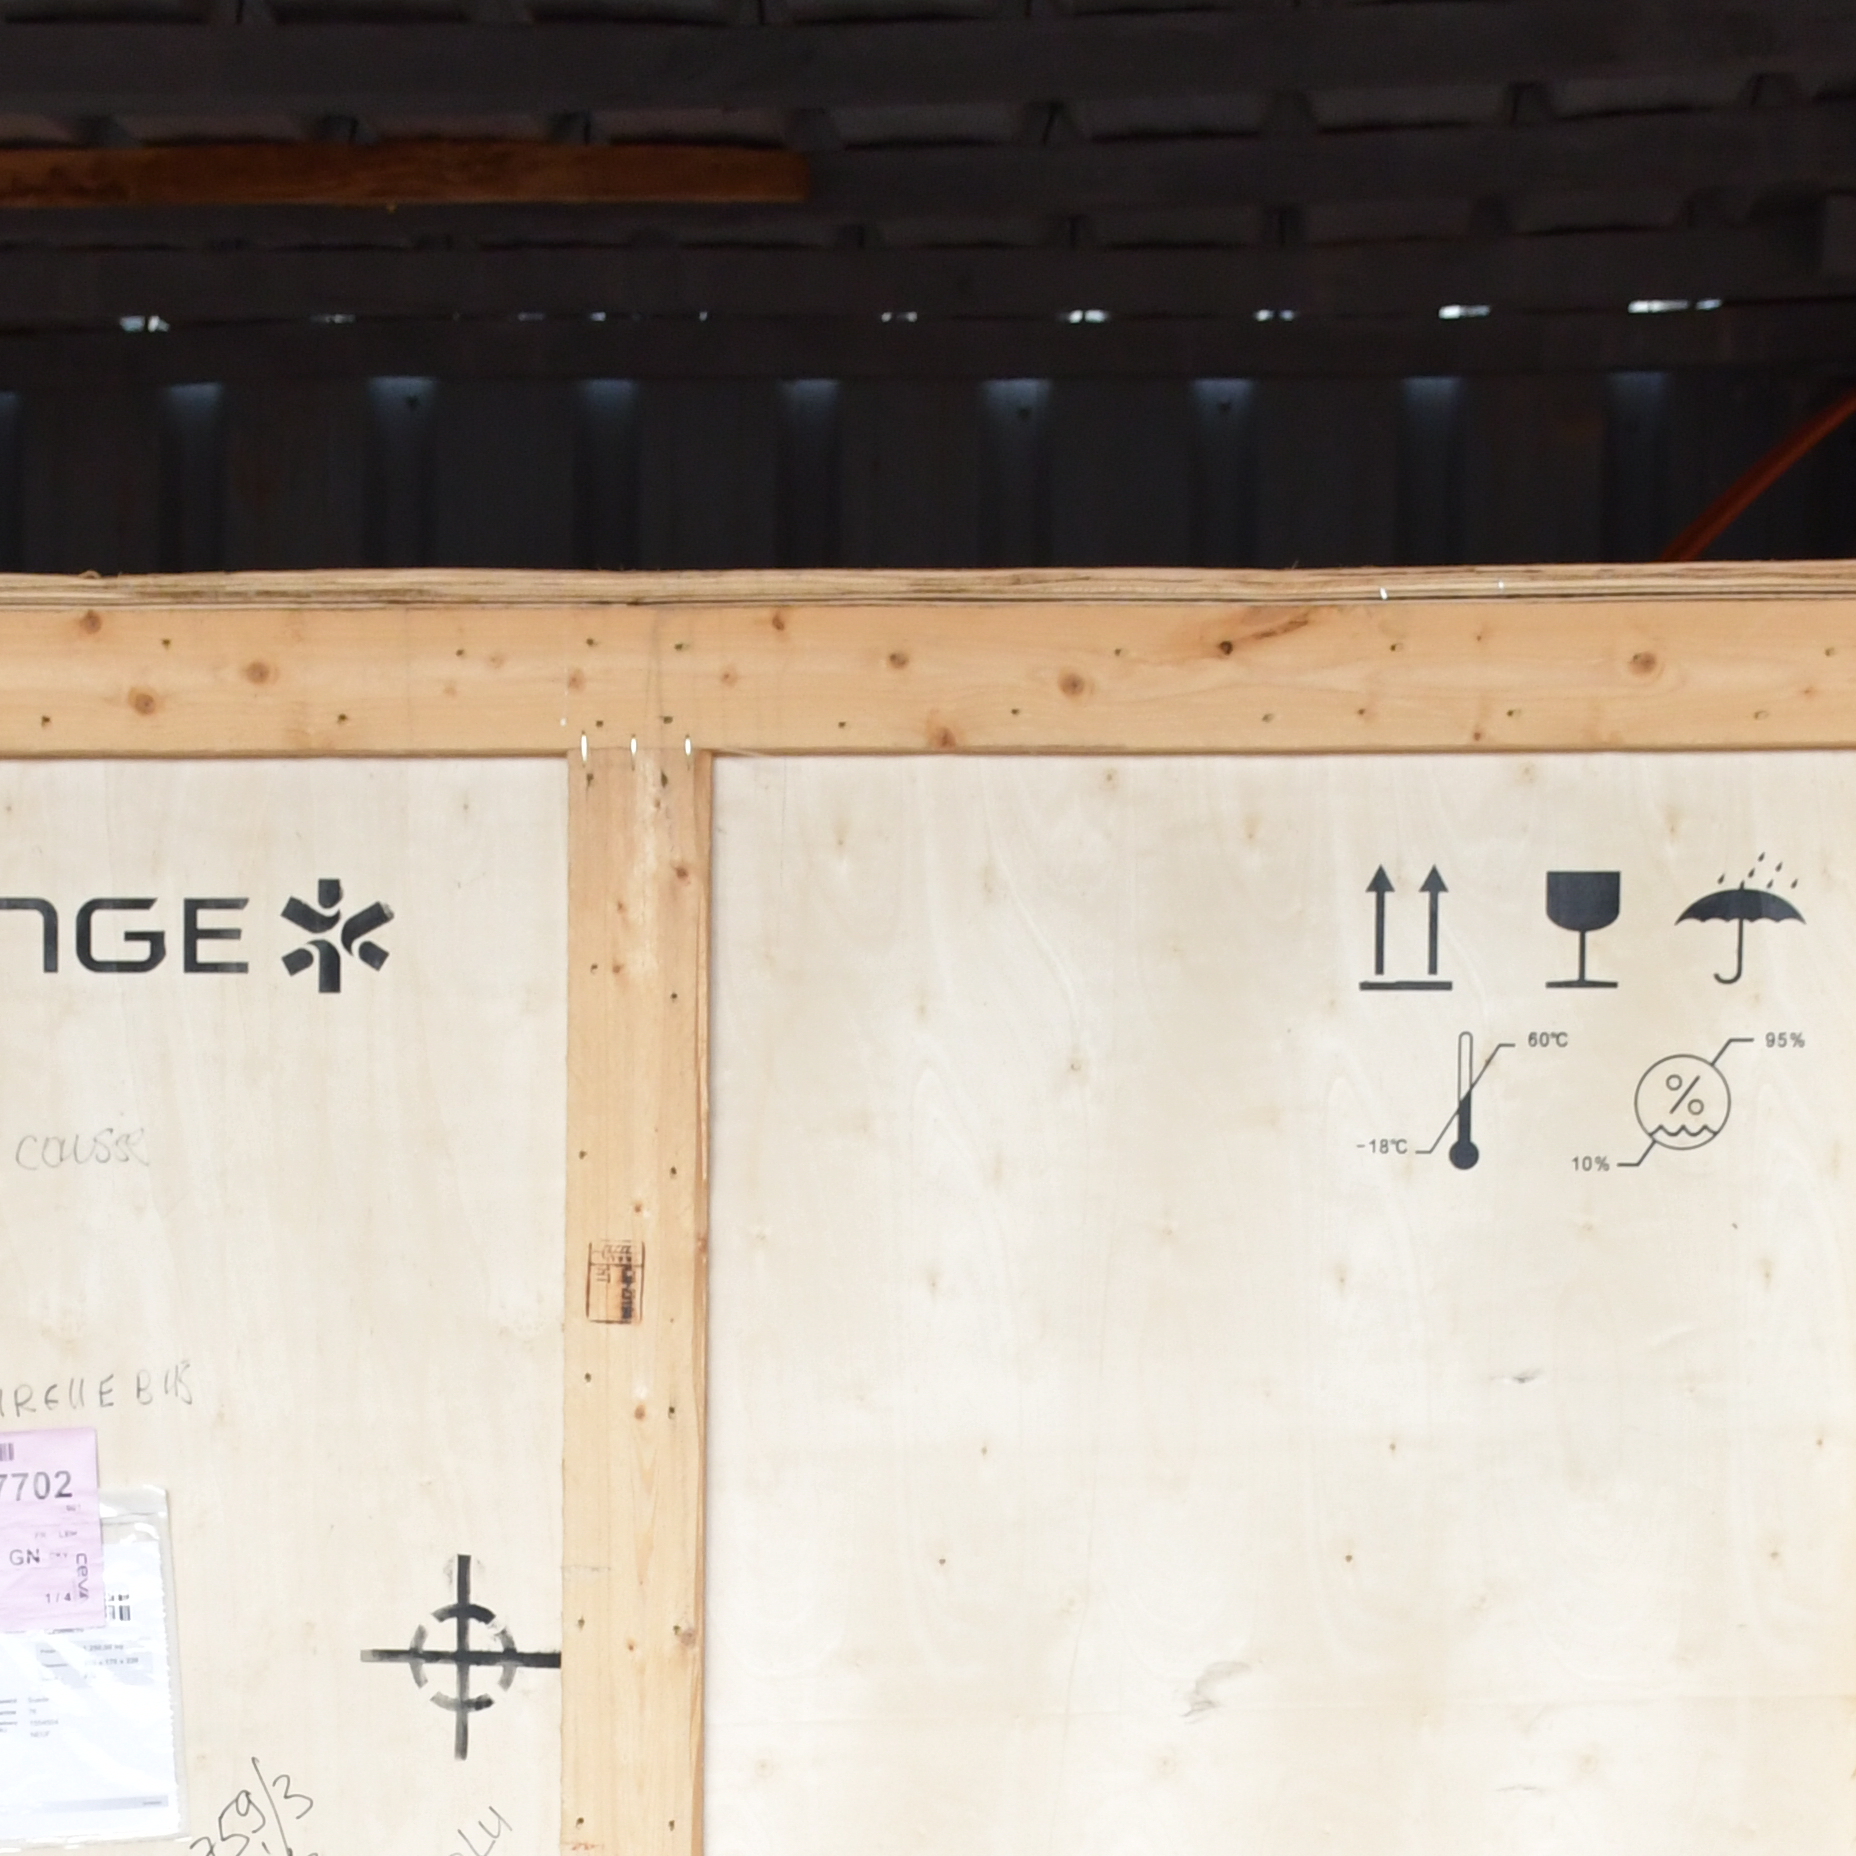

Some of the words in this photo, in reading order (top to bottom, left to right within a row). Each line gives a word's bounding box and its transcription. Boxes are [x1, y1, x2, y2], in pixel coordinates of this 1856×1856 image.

[1527, 1031, 1569, 1049] 60°C
[1765, 1031, 1806, 1049] 95%
[1571, 1156, 1610, 1174] 10%
[9, 1548, 40, 1566] GN
